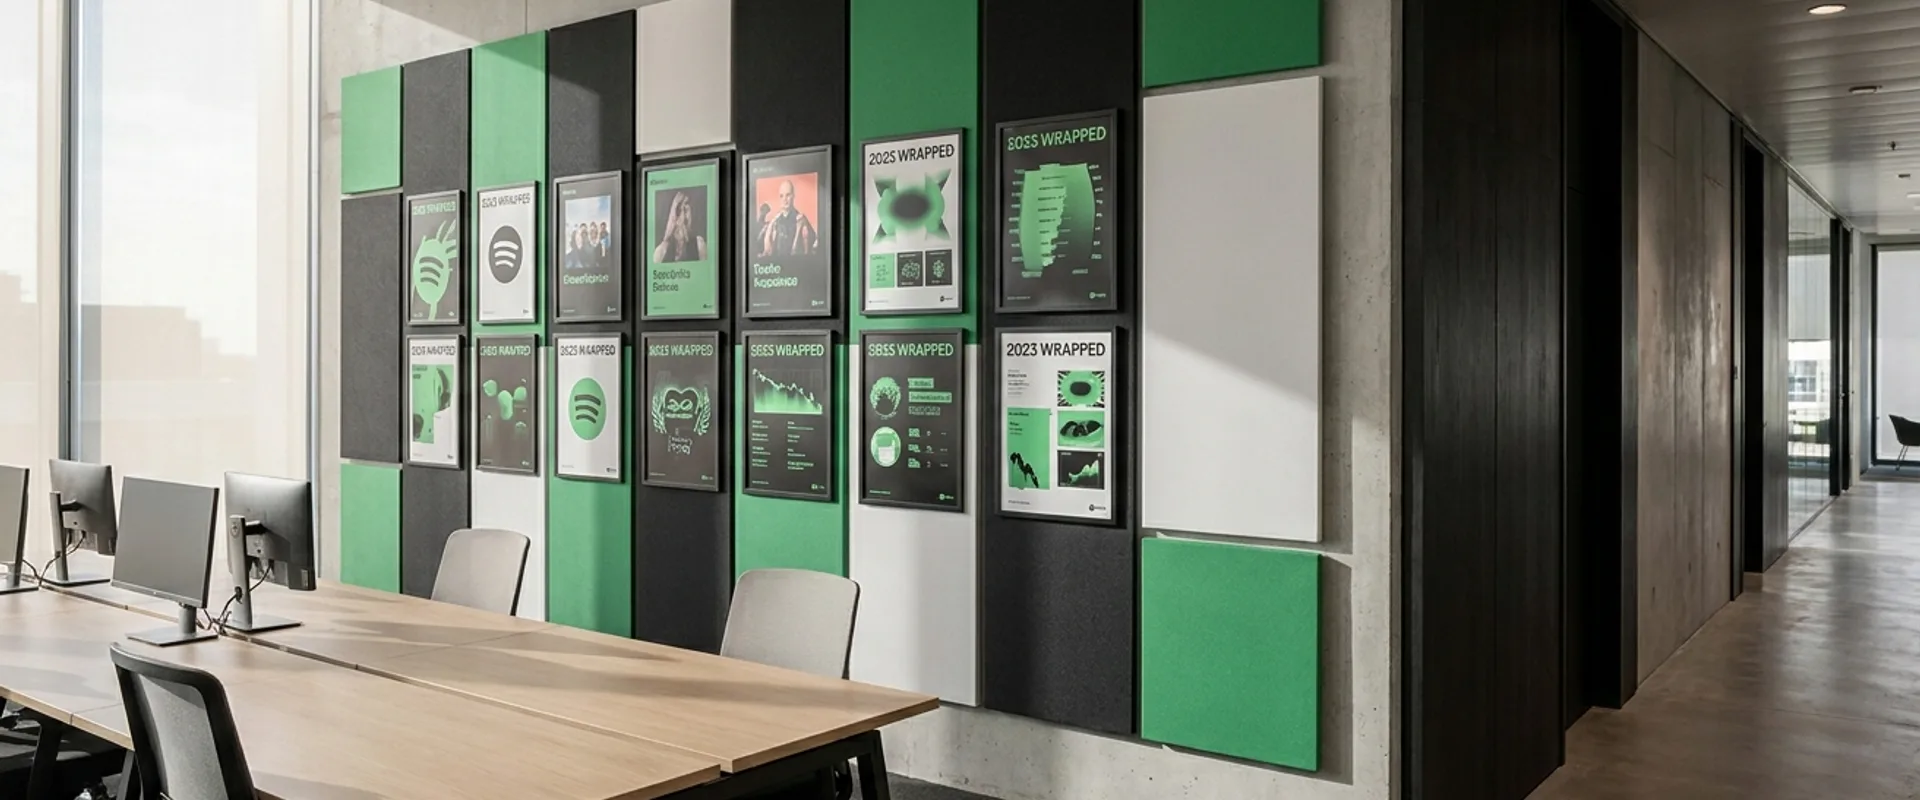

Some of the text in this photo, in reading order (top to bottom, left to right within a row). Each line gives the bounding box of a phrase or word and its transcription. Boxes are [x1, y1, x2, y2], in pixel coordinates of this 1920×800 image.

[1040, 126, 1107, 147] WRAPPED
[897, 143, 955, 162] WRAPPED
[896, 343, 954, 356] WRAPPED
[1006, 342, 1106, 356] 2023 WRAPPED
